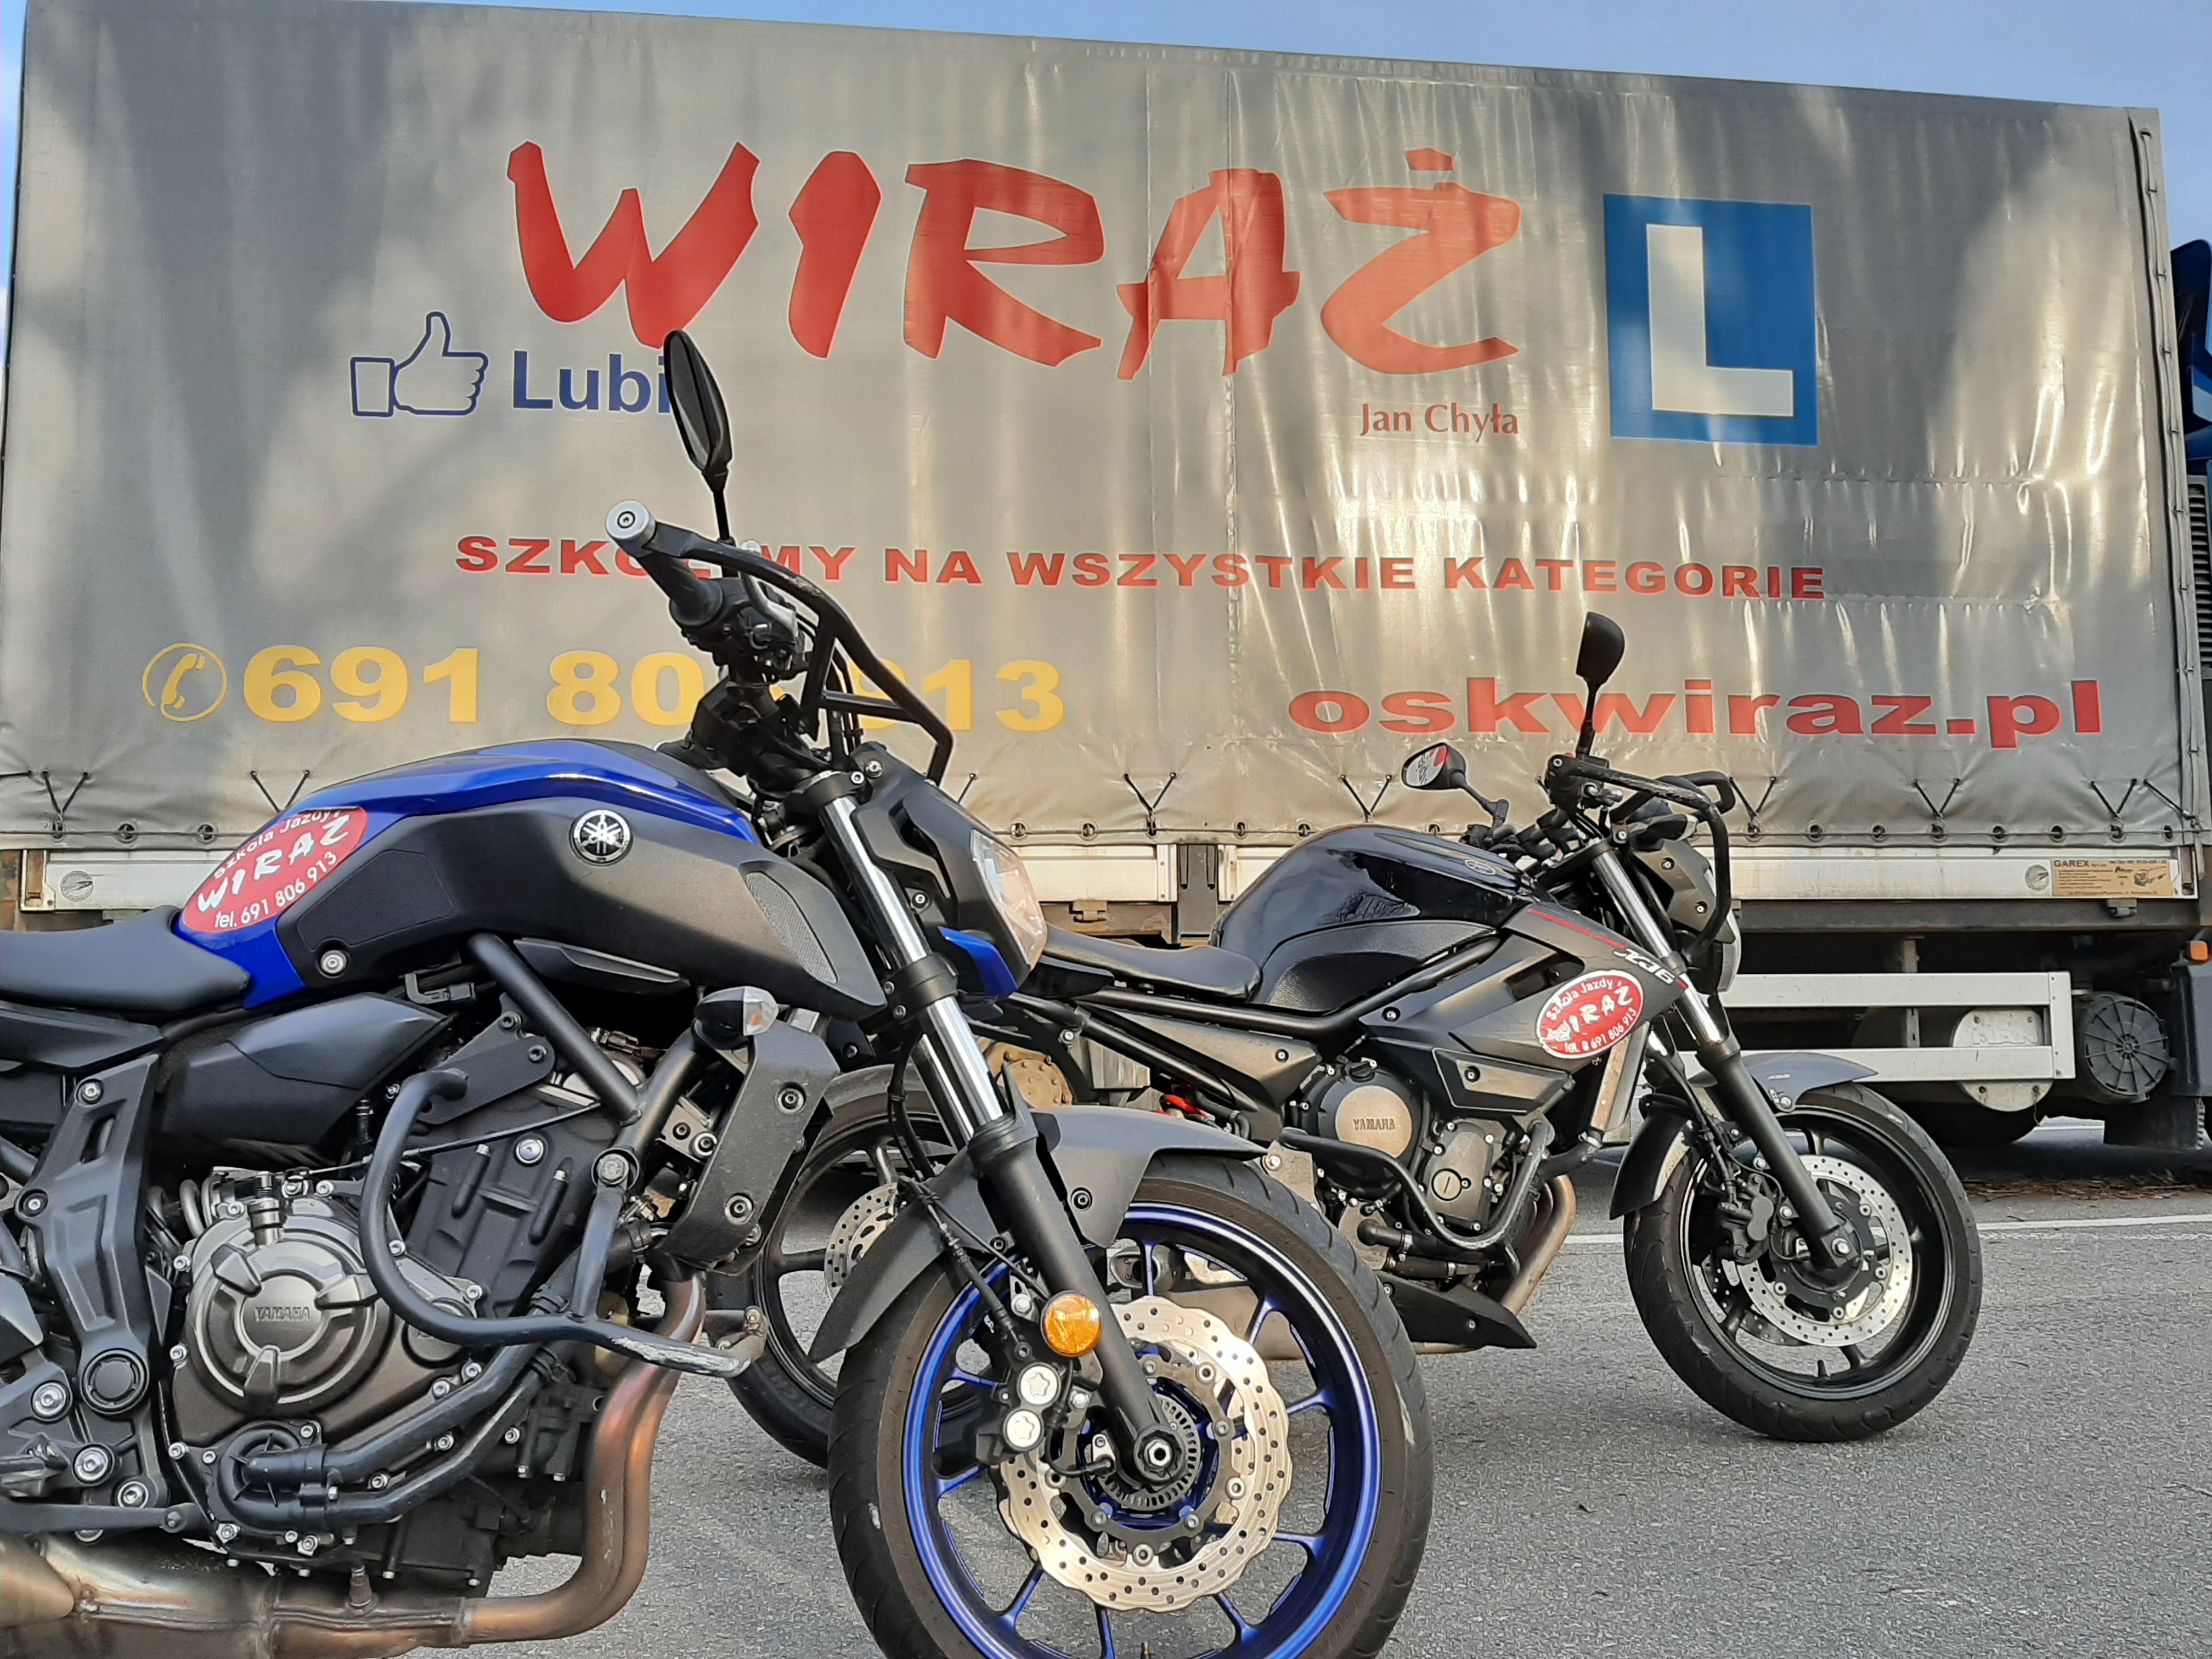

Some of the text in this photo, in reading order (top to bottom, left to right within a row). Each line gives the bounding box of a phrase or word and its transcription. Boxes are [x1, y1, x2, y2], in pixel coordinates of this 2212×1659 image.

[507, 141, 1520, 379] WIRAŻ
[1646, 223, 1793, 417] L
[512, 351, 670, 413] Lubi
[1361, 403, 1519, 442] Jan Chyła
[885, 549, 983, 585] NA
[1007, 553, 1417, 591] WSZYSTKIE
[1444, 557, 1825, 599] KATEGORIE
[244, 646, 479, 723] 691
[548, 652, 786, 727] 80
[1289, 677, 2102, 749] oskwiraz.pl
[215, 851, 337, 928] tel. 691 806 913
[1581, 978, 1613, 994] Jazdy
[1591, 1033, 1607, 1049] 691
[1607, 1022, 1624, 1041] 806
[1622, 1007, 1638, 1026] 913
[1353, 1118, 1396, 1131] YAMAHA
[255, 1306, 310, 1322] YAMAHA
